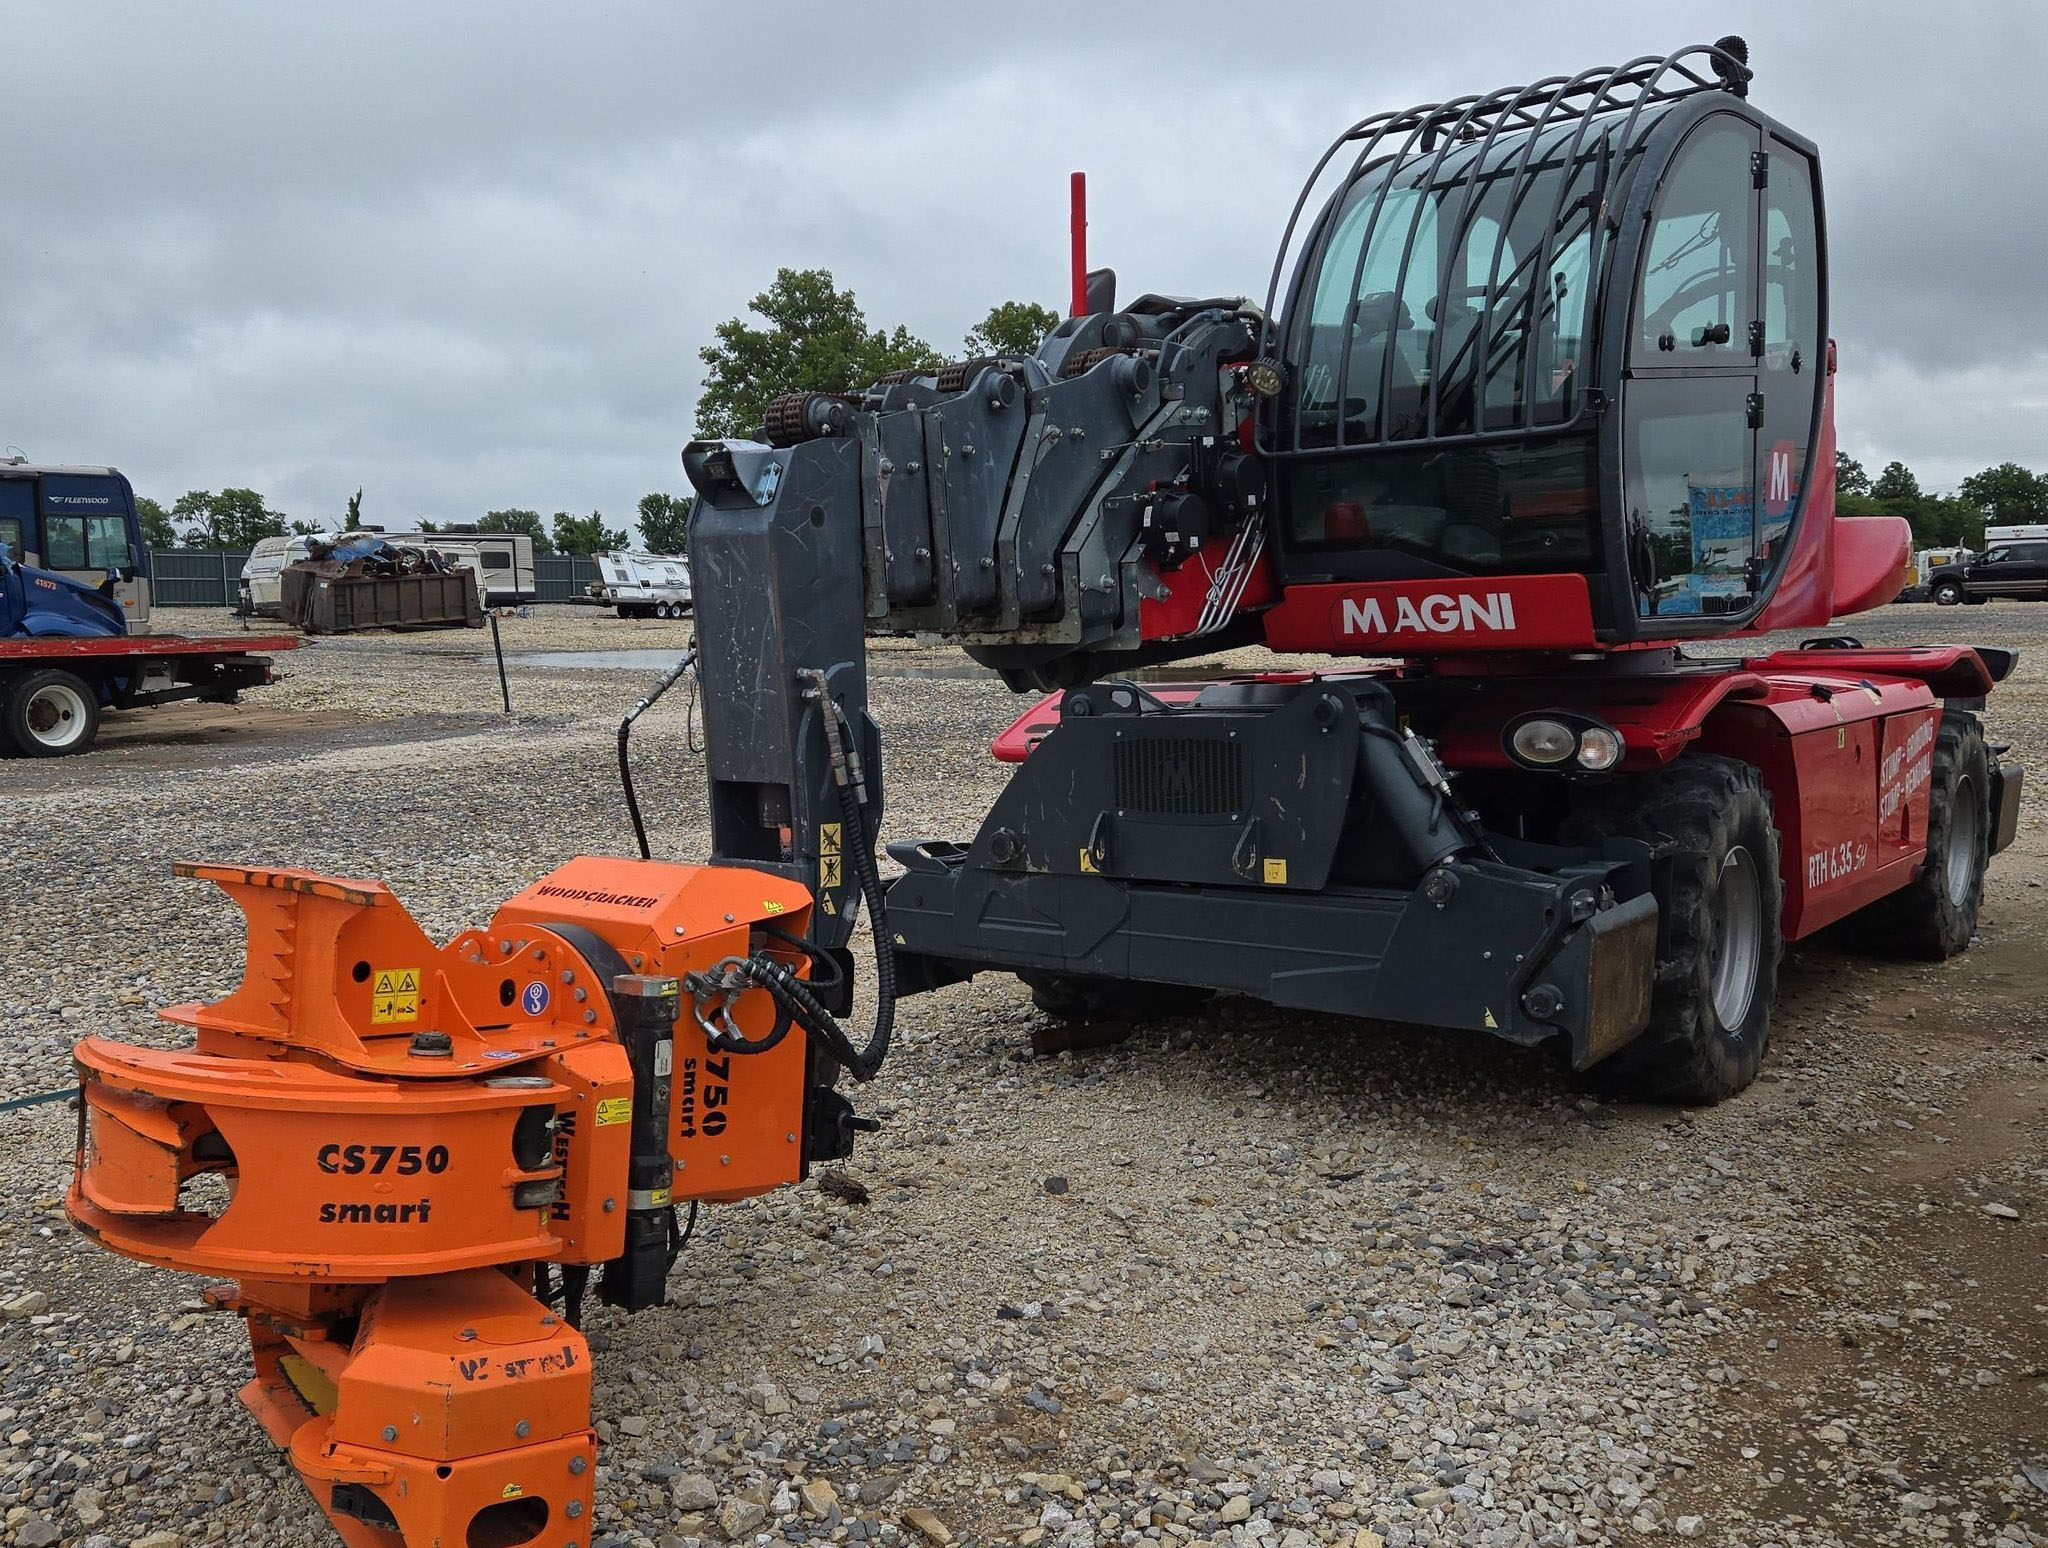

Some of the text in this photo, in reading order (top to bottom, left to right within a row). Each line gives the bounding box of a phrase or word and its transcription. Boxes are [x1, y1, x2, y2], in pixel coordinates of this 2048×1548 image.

[1770, 452, 1789, 501] M
[1343, 592, 1516, 634] MAGNI
[1880, 747, 1902, 788] STUMP
[1906, 716, 1933, 763] GRINDING
[1880, 782, 1901, 824] STUMP
[1906, 751, 1931, 799] REMOVAL
[1809, 850, 1827, 889] RTH
[1831, 841, 1852, 879] 6.35
[537, 885, 658, 908] WOODCRACKER
[681, 1057, 697, 1138] smart
[317, 1144, 449, 1175] CS750
[551, 1108, 577, 1221] WESTH
[319, 1198, 432, 1223] smart
